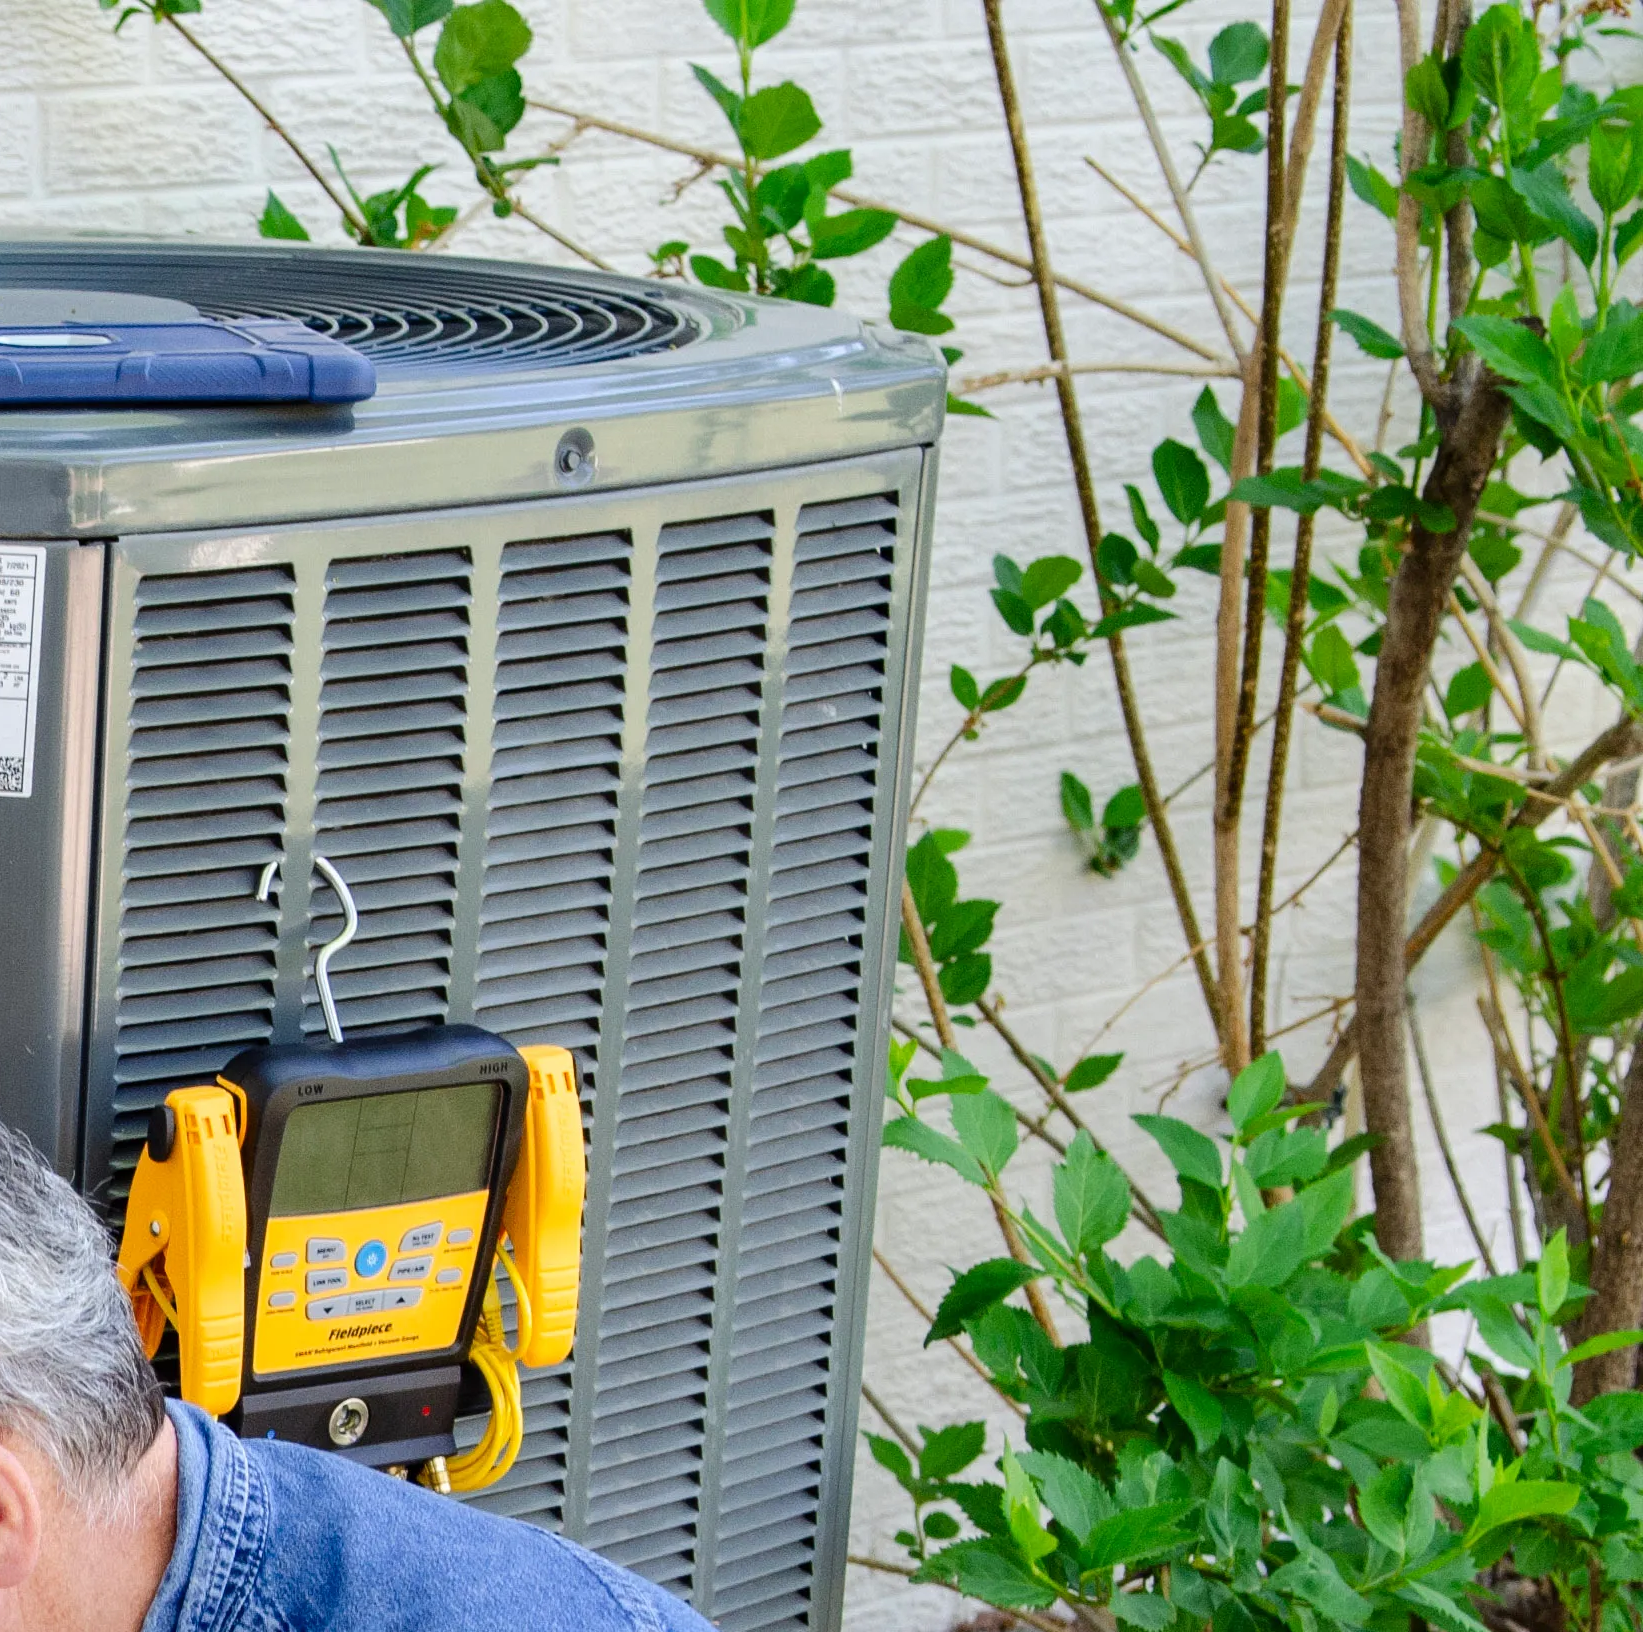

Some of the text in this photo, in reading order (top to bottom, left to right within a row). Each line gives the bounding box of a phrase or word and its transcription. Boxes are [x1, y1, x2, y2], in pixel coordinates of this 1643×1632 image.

[6, 562, 29, 571] 7/2021
[479, 1061, 509, 1076] HIGH
[297, 1083, 324, 1097] LOW
[328, 1321, 394, 1342] Fieldpiece
[314, 1345, 347, 1356] Refrigerant
[347, 1340, 373, 1350] Manifold
